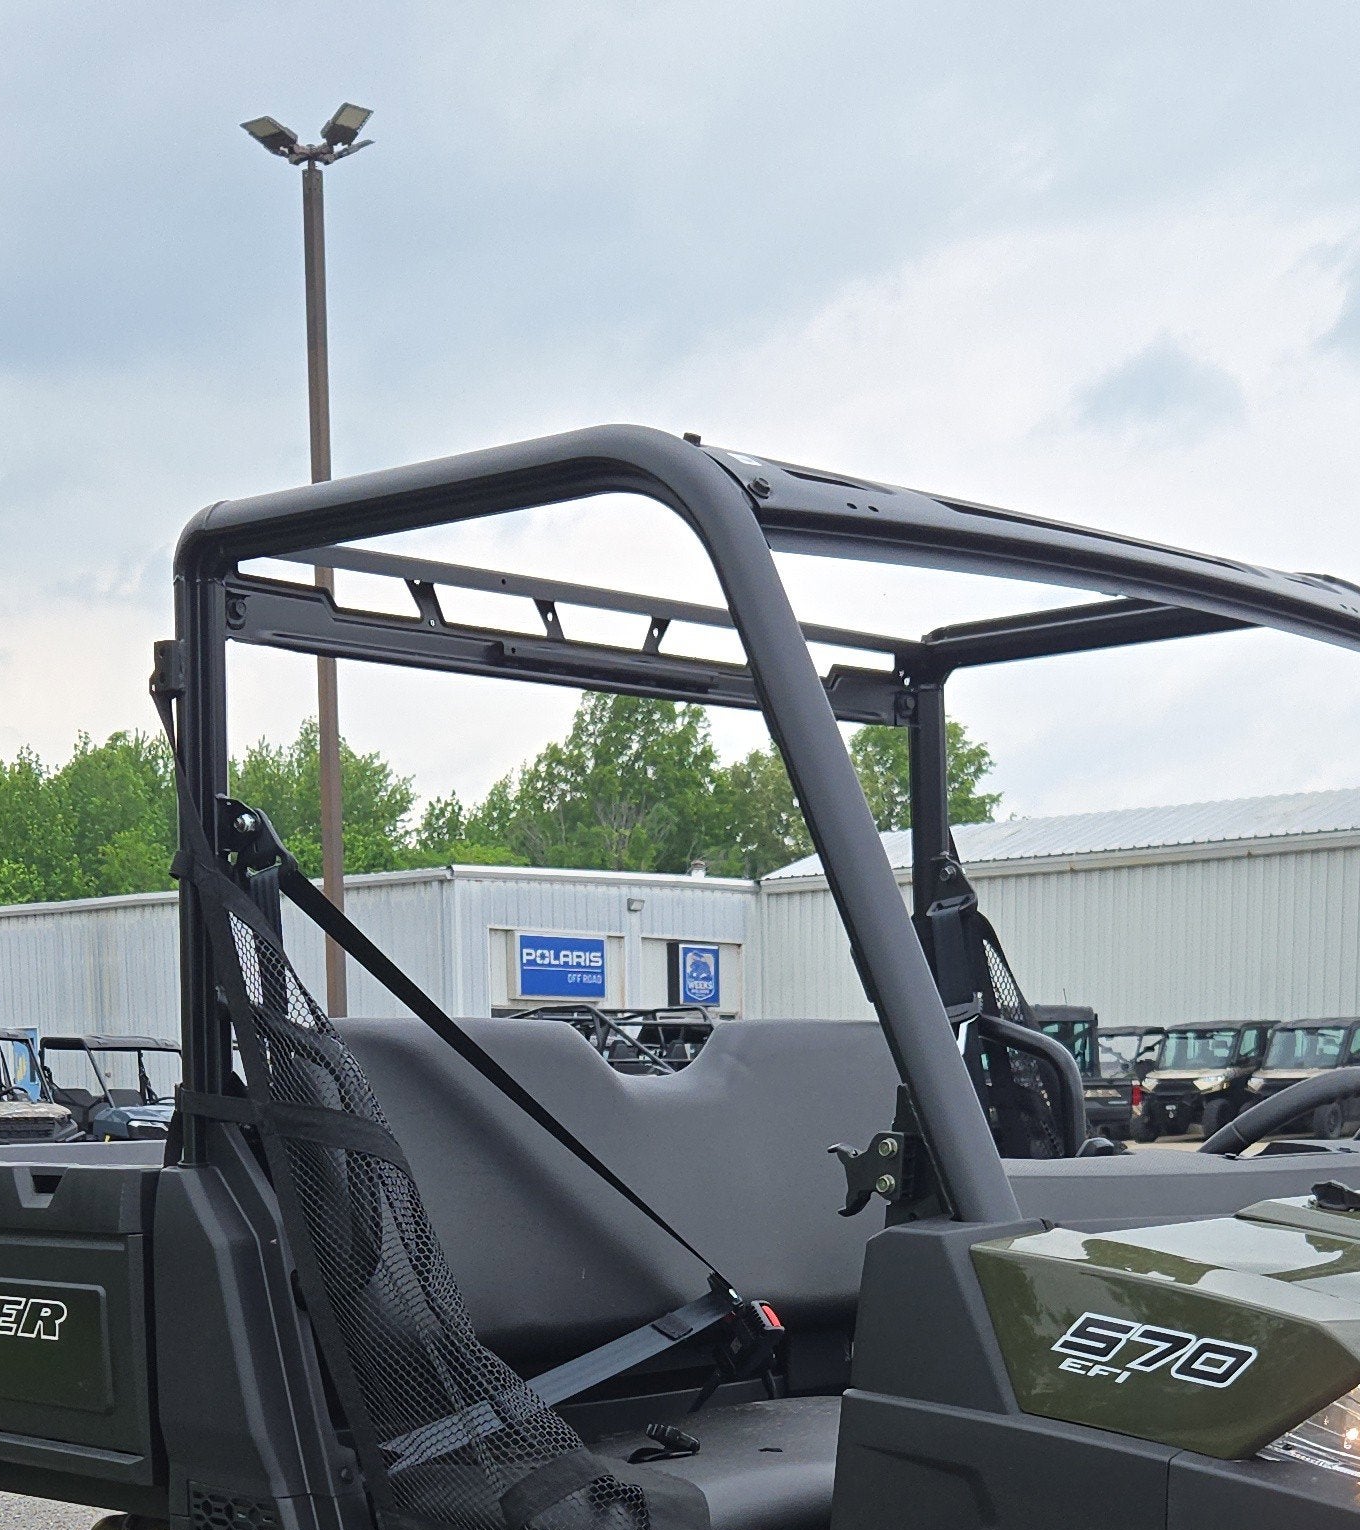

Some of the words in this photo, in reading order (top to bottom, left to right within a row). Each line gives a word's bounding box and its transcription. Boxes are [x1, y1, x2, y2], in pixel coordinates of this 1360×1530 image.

[523, 948, 602, 967] POLARIS
[567, 973, 582, 983] OFF
[583, 973, 602, 984] ROAD
[1050, 1311, 1259, 1389] 570
[1058, 1357, 1132, 1384] EFI
